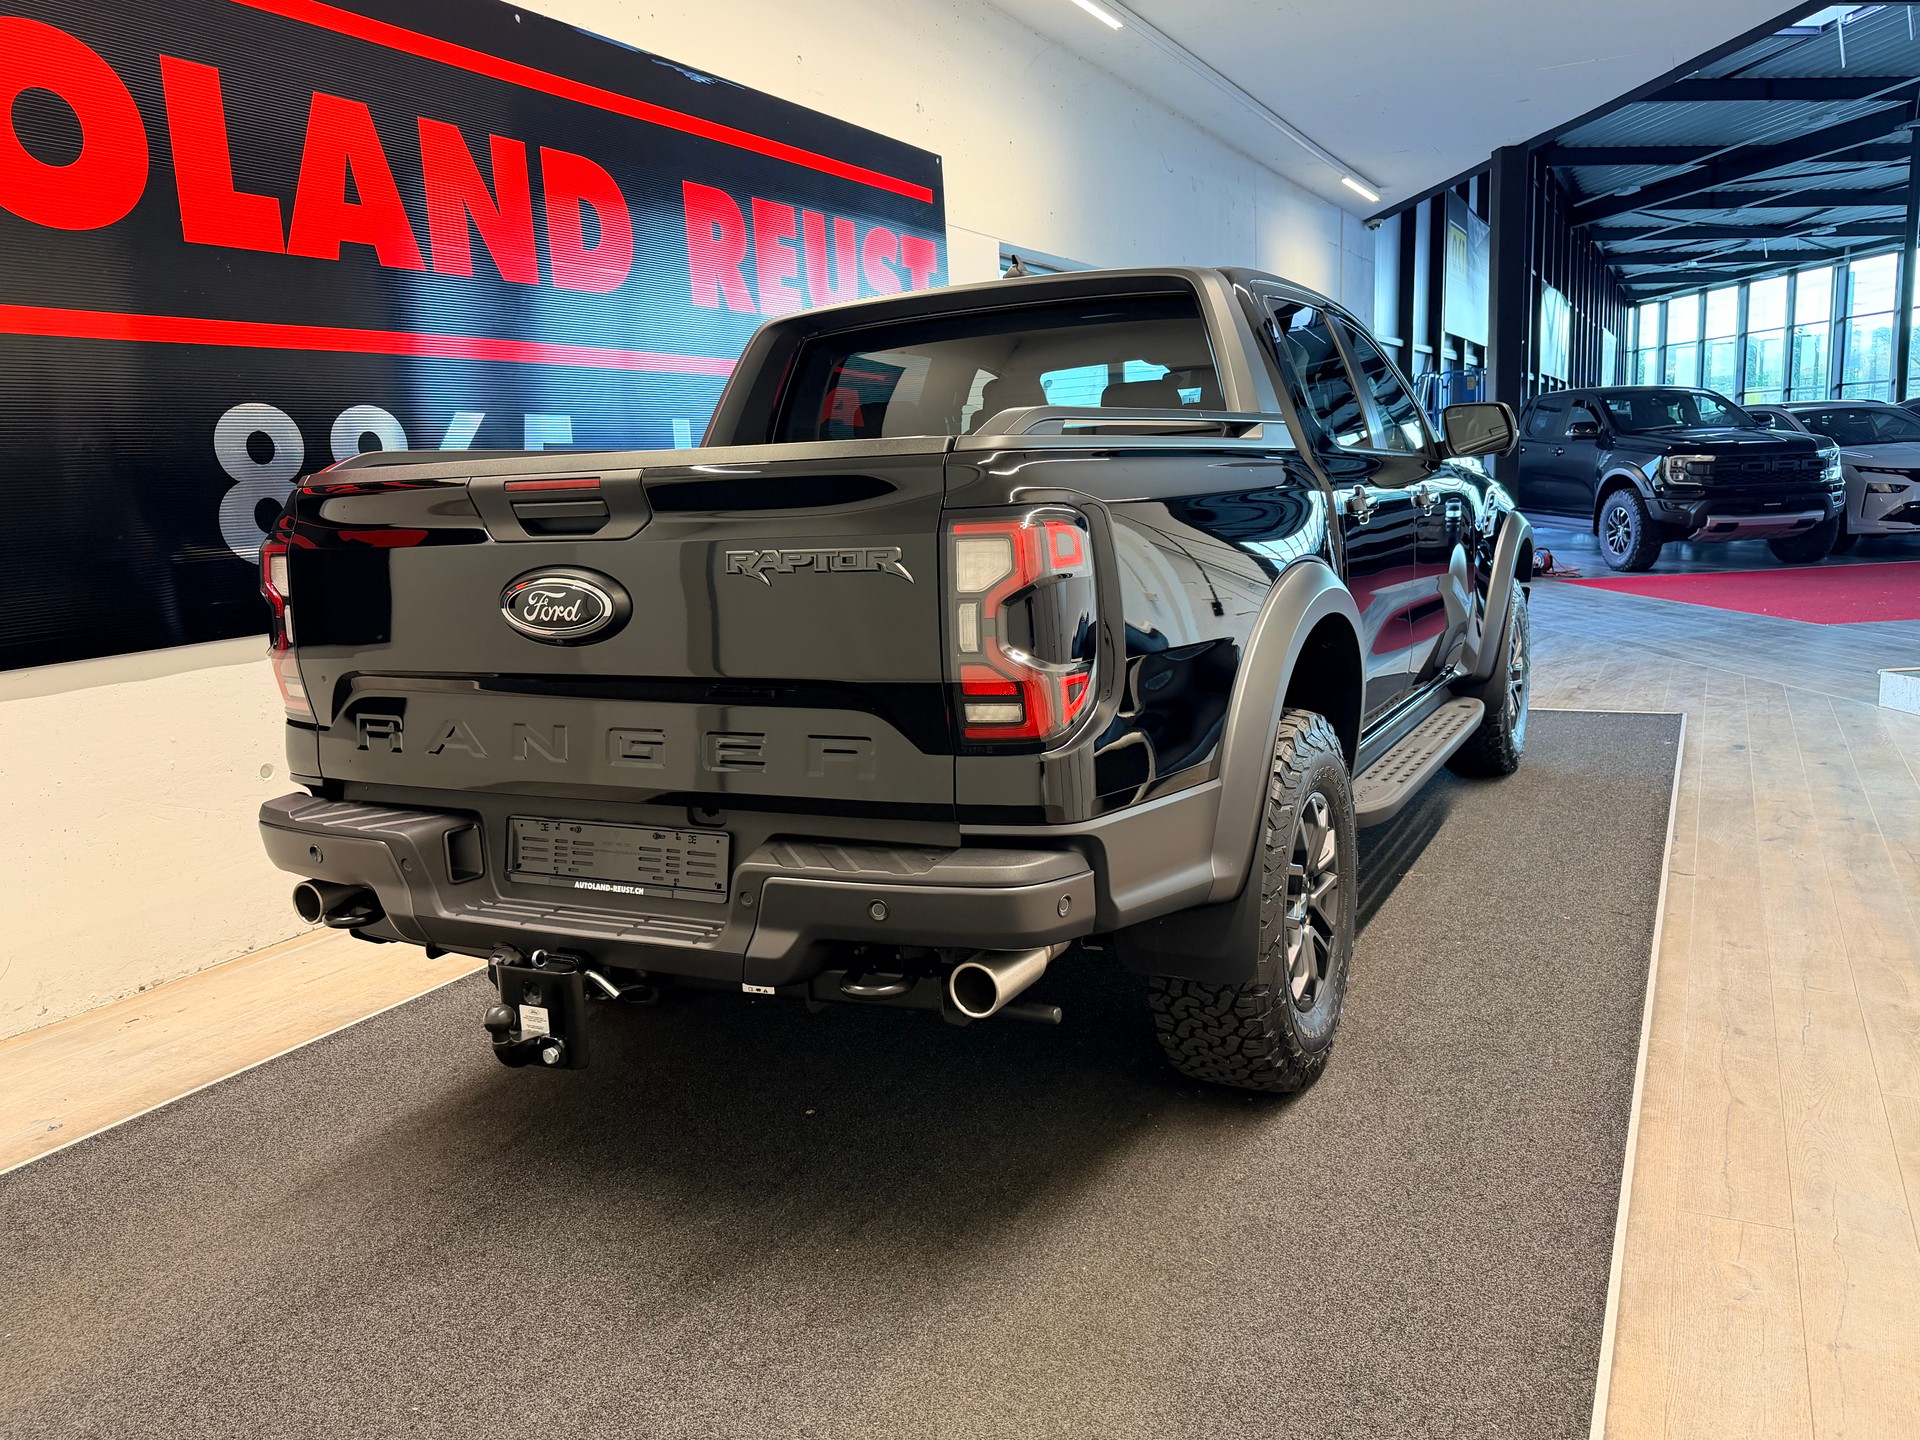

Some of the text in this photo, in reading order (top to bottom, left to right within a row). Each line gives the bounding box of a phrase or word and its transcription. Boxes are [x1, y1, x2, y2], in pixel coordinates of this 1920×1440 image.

[683, 181, 936, 314] REUST
[726, 546, 915, 587] RAPTOR
[523, 590, 581, 622] Ford
[356, 714, 875, 780] RANGER
[574, 881, 644, 896] AUTOLAND-REUST.CH
